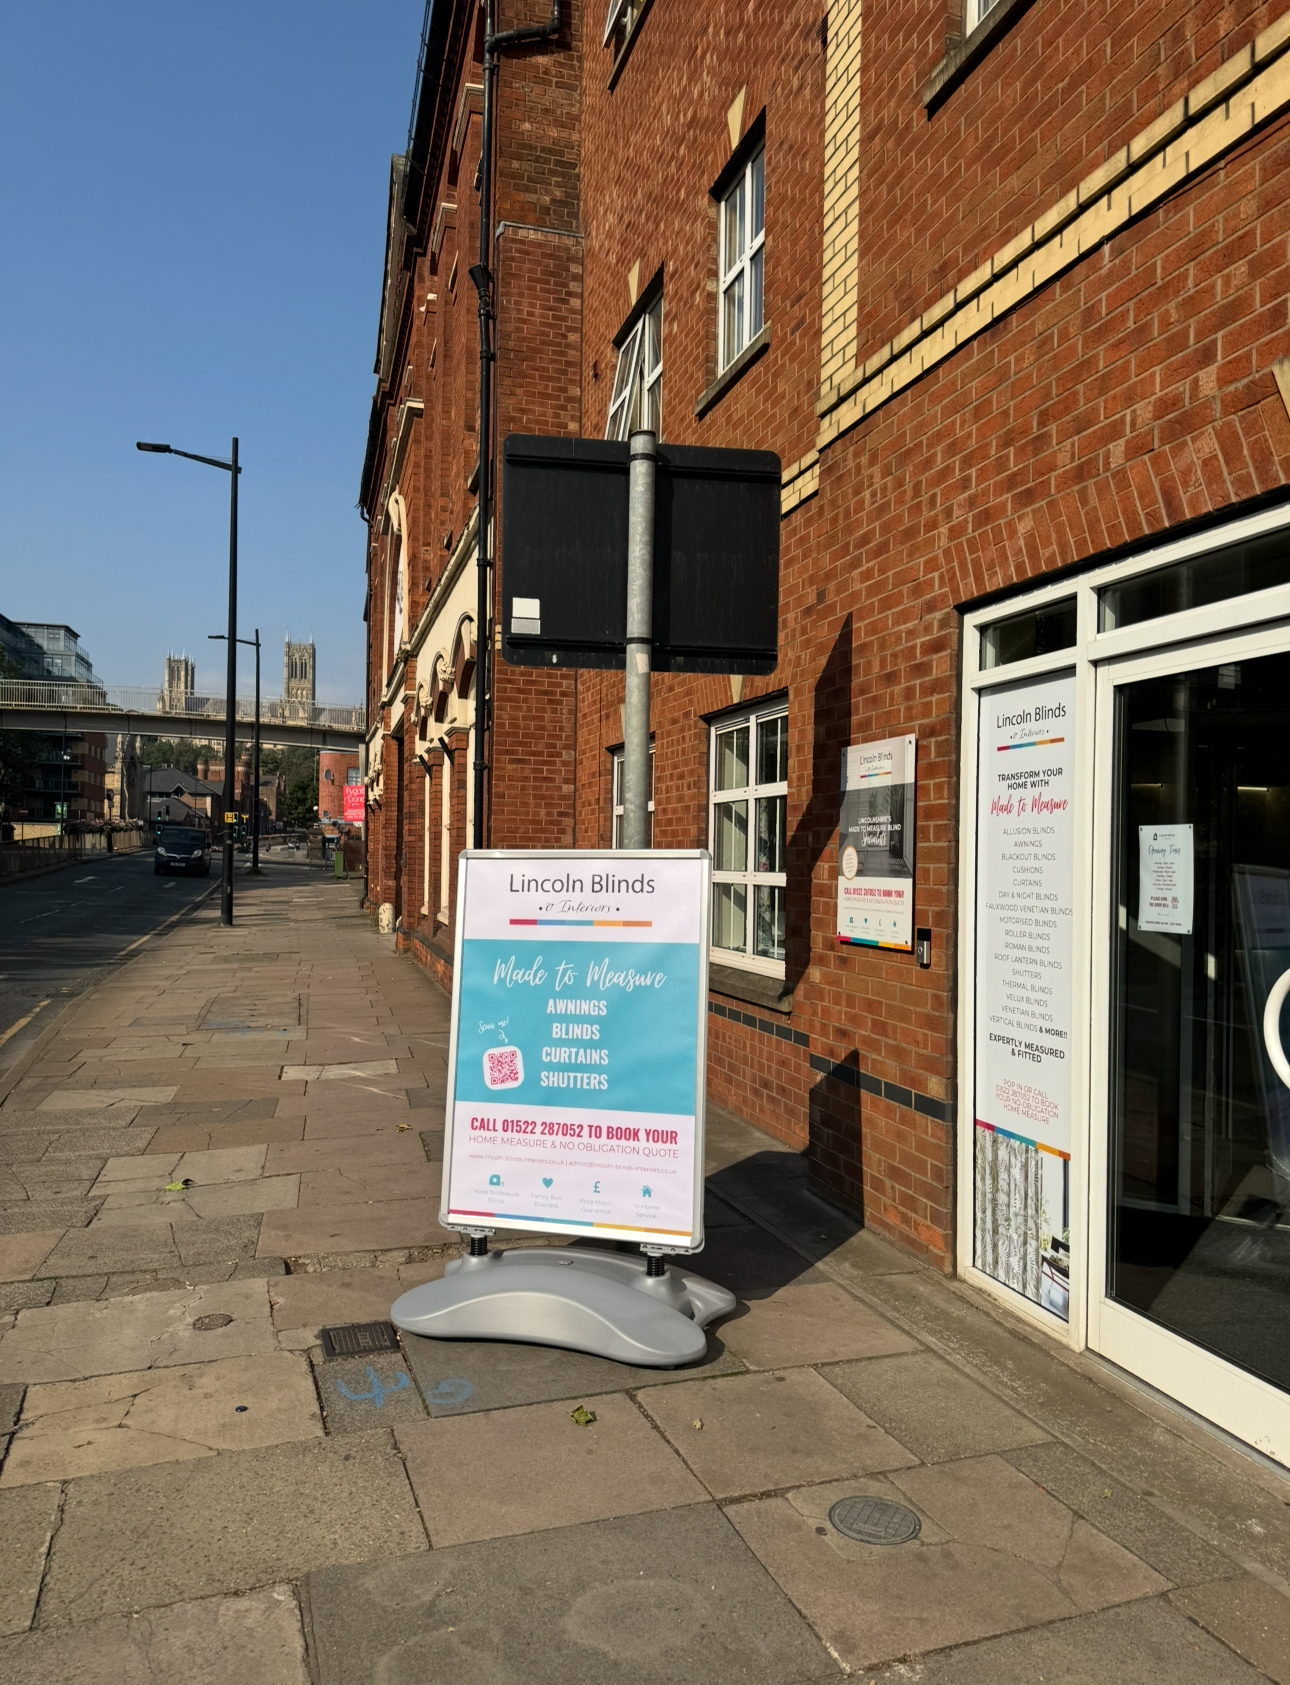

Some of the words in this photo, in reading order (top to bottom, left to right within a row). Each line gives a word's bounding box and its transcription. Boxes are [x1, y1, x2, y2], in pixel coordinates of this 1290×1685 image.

[997, 710, 1032, 728] Lincoln
[1035, 702, 1066, 722] Blinds
[860, 754, 877, 765] Lincoln
[878, 751, 893, 762] Blinds
[998, 770, 1040, 782] TRANSFORM
[1042, 768, 1063, 777] YOUR
[1008, 780, 1028, 790] HOME
[1030, 780, 1049, 788] WITH
[991, 794, 1014, 817] Made
[1018, 796, 1026, 817] to
[1032, 792, 1068, 814] Measure
[510, 874, 584, 892] Lincoln
[591, 874, 655, 893] Blinds
[1013, 879, 1042, 887] CURTAINS
[1036, 893, 1058, 901] BLINDS
[557, 900, 611, 913] Interiors
[1020, 906, 1049, 914] VENETIAN
[1050, 907, 1073, 916] BLINDS
[999, 917, 1033, 926] MOTORISED
[1035, 919, 1057, 928] BLINDS
[1005, 929, 1027, 938] ROLLER
[1028, 932, 1050, 941] BLINDS
[1005, 942, 1026, 951] ROMAN
[1028, 944, 1050, 954] BLINDS
[994, 953, 1010, 961] ROOF
[1011, 955, 1038, 966] LANTERN
[1040, 959, 1062, 970] BLINDS
[494, 956, 548, 988] Made
[555, 960, 578, 991] to
[586, 958, 667, 992] Measure
[1012, 969, 1042, 980] SHUTTERS
[1002, 980, 1029, 991] THERMAL
[1030, 984, 1053, 995] BLINDS
[547, 999, 607, 1016] AWNINGS
[1006, 993, 1024, 1003] VELUX
[1026, 996, 1048, 1008] BLINDS
[1001, 1005, 1030, 1017] VENETIAN
[1031, 1010, 1053, 1022] BLINDS
[552, 1023, 600, 1040] BLINDS
[989, 1015, 1015, 1027] VERTICAL
[1017, 1021, 1038, 1032] BLINDS
[1045, 1026, 1068, 1039] MORE!!
[990, 1032, 1022, 1048] EXPERTLY
[1024, 1040, 1065, 1060] MEASURED
[542, 1047, 609, 1065] CURTAINS
[1011, 1048, 1016, 1056] &
[1018, 1050, 1042, 1063] FITTED
[540, 1071, 608, 1090] SHUTTERS
[1004, 1079, 1015, 1088] POP
[1017, 1082, 1023, 1091] IN
[1024, 1084, 1032, 1094] OR
[1033, 1088, 1048, 1099] CALL
[995, 1093, 1010, 1104] YOUR
[1012, 1097, 1059, 1119] NO-OBLIGATION
[996, 1084, 1010, 1095] 01522
[1011, 1089, 1030, 1102] 287052
[1032, 1095, 1039, 1105] TO
[1041, 1098, 1058, 1111] BOOK
[1004, 1104, 1020, 1115] HOME
[1022, 1109, 1050, 1125] MEASURE
[470, 1117, 498, 1132] CALL
[502, 1119, 536, 1134] 01522
[540, 1121, 584, 1138] 287052
[587, 1125, 602, 1139] TO
[606, 1126, 640, 1142] BOOK
[644, 1128, 678, 1145] YOUR
[469, 1135, 498, 1145] HOME
[501, 1137, 548, 1149] MEASURE
[551, 1140, 557, 1149] &
[560, 1141, 575, 1150] NO
[577, 1142, 640, 1155] OBLIGATION
[642, 1146, 679, 1158] QUOTE
[469, 1154, 564, 1165] www.lincoln-blinds-interiors.co.uk
[568, 1160, 677, 1174] admin@lincoln-blinds-interiors.co.uk
[530, 1193, 549, 1201] Family
[580, 1206, 611, 1215] Guarantee
